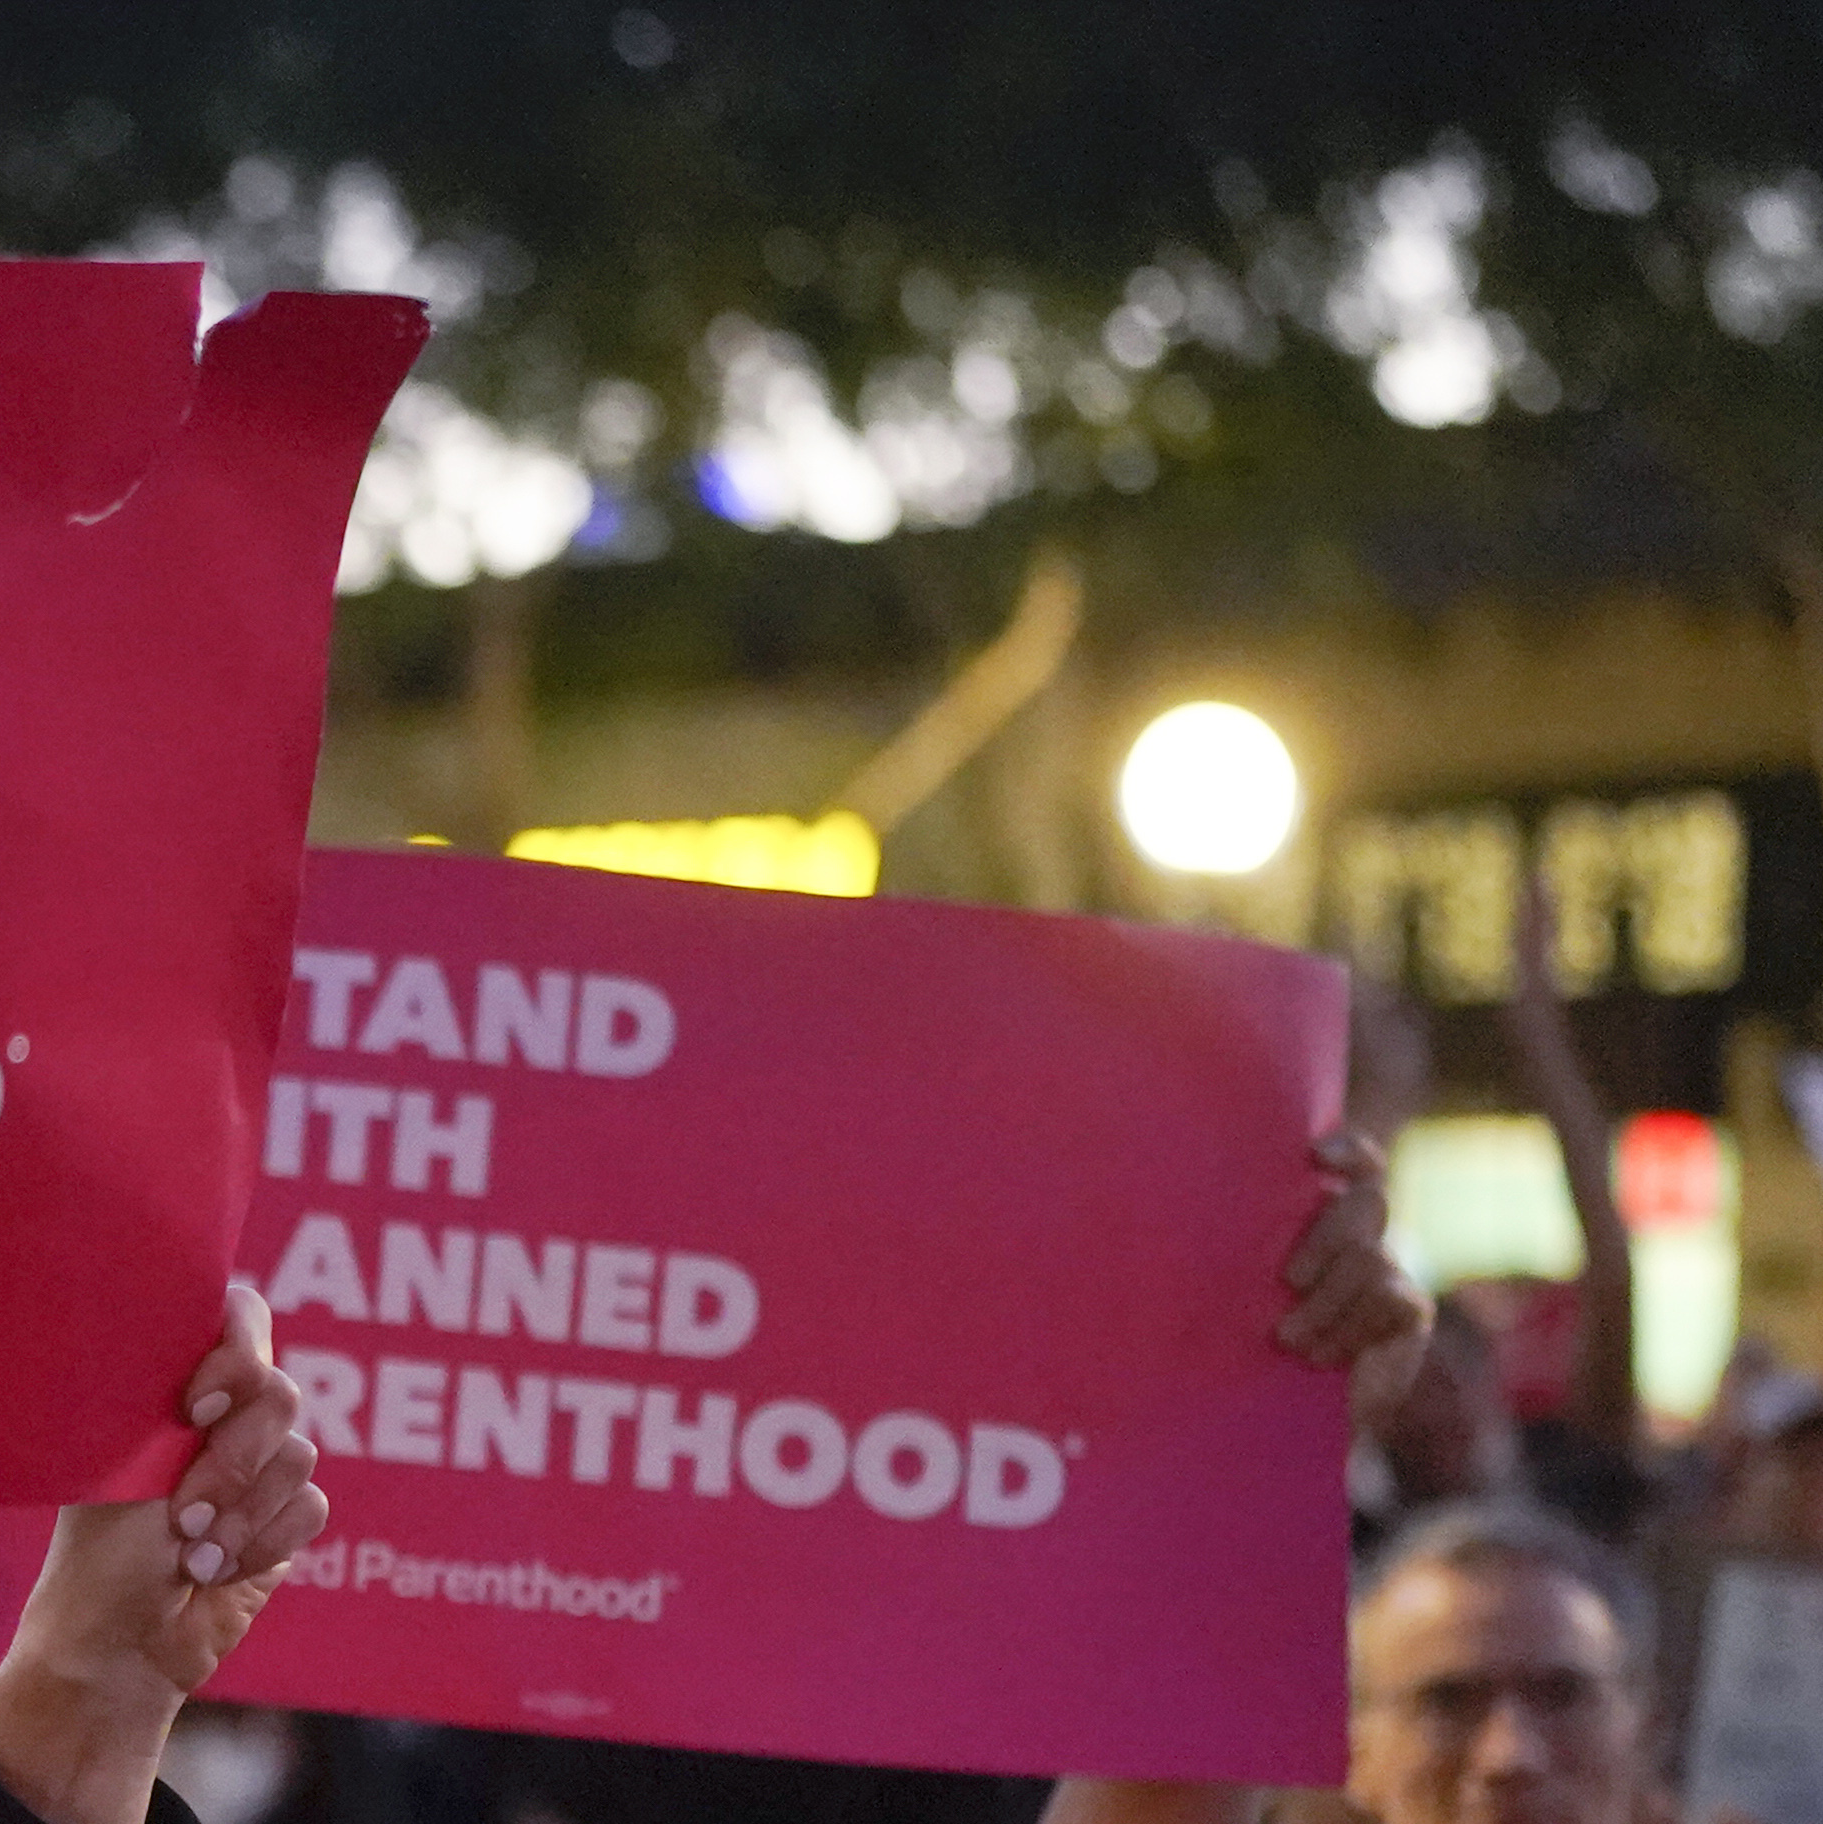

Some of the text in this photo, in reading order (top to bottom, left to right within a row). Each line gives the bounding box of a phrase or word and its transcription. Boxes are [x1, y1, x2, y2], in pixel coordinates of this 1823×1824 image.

[292, 948, 676, 1078] TAND
[263, 1075, 494, 1198] ITH
[230, 1213, 760, 1360] ANNED
[282, 1345, 1067, 1529] RENTHOOD
[352, 1538, 664, 1623] Parenthood
